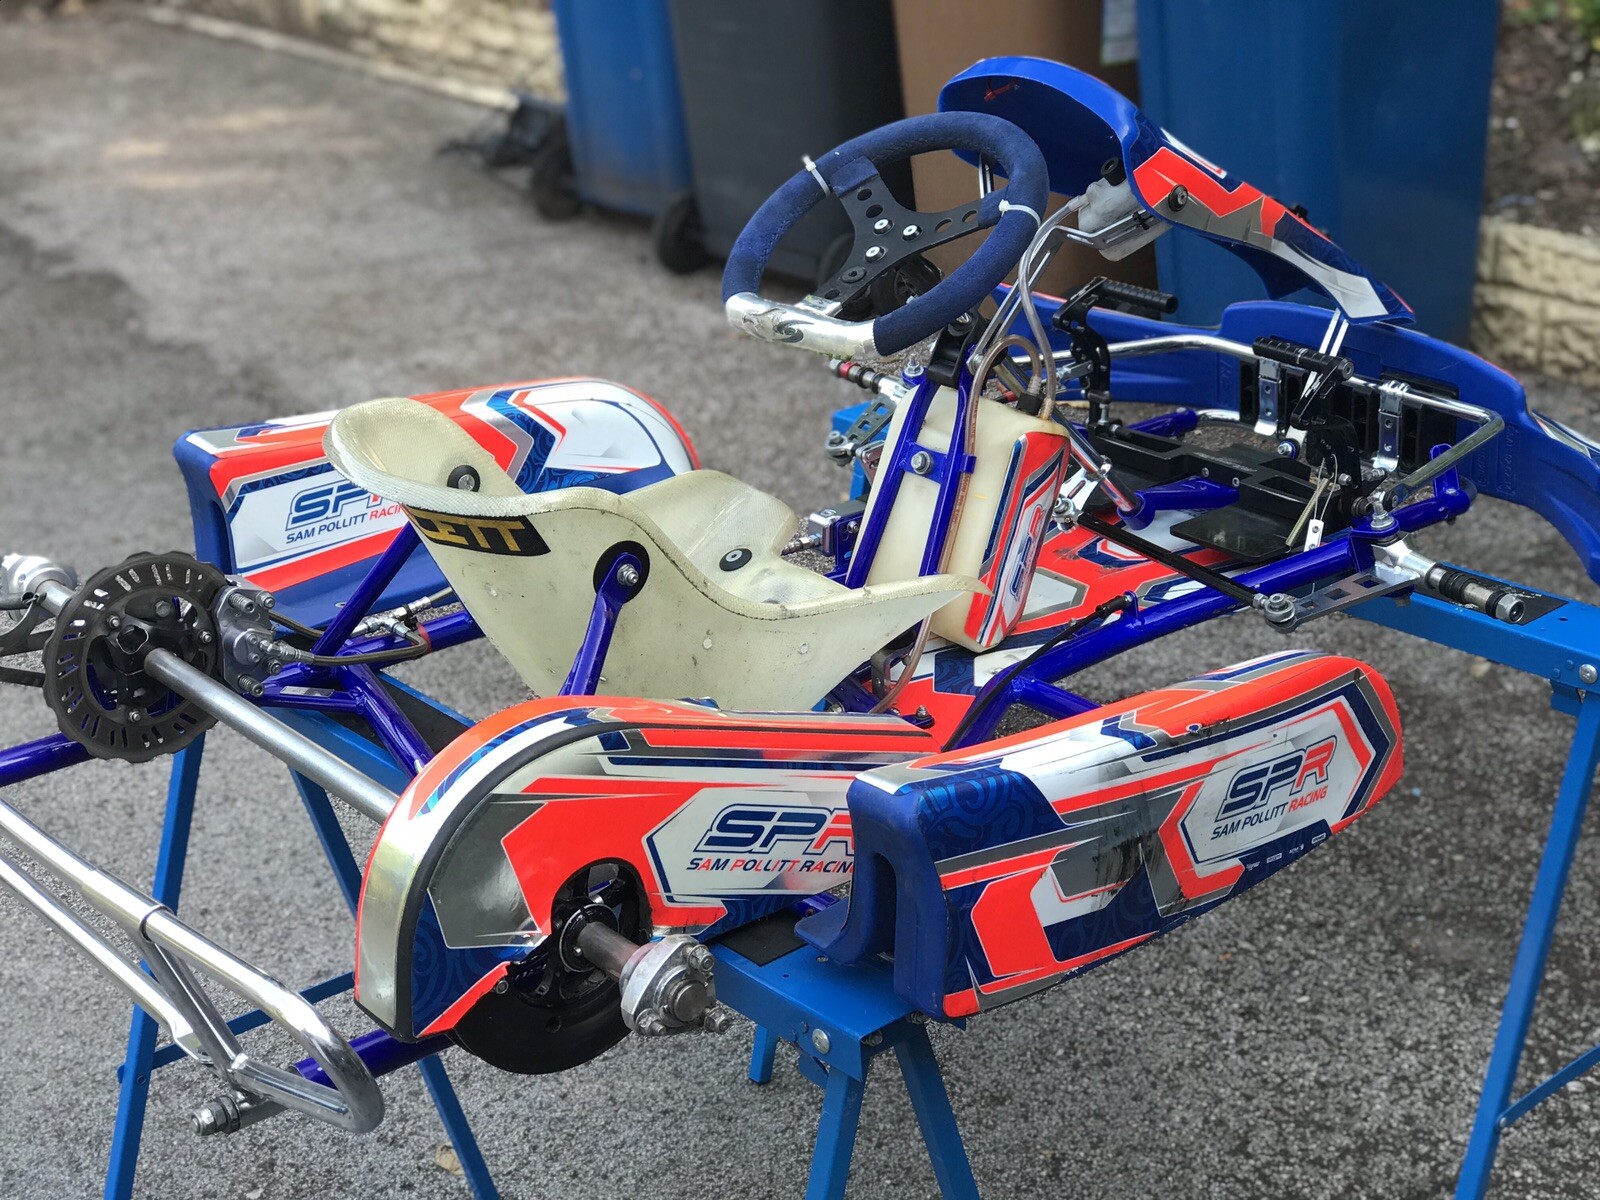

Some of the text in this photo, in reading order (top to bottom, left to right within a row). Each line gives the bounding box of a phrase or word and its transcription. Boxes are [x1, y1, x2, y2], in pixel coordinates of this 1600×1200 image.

[286, 479, 383, 530] SP
[286, 527, 315, 544] SAM
[318, 513, 367, 535] POLLITT
[1215, 735, 1337, 822] SPR
[1210, 785, 1328, 840] SAM POLLITT RACING
[686, 857, 730, 871] SAM
[729, 858, 800, 872] POLLITT
